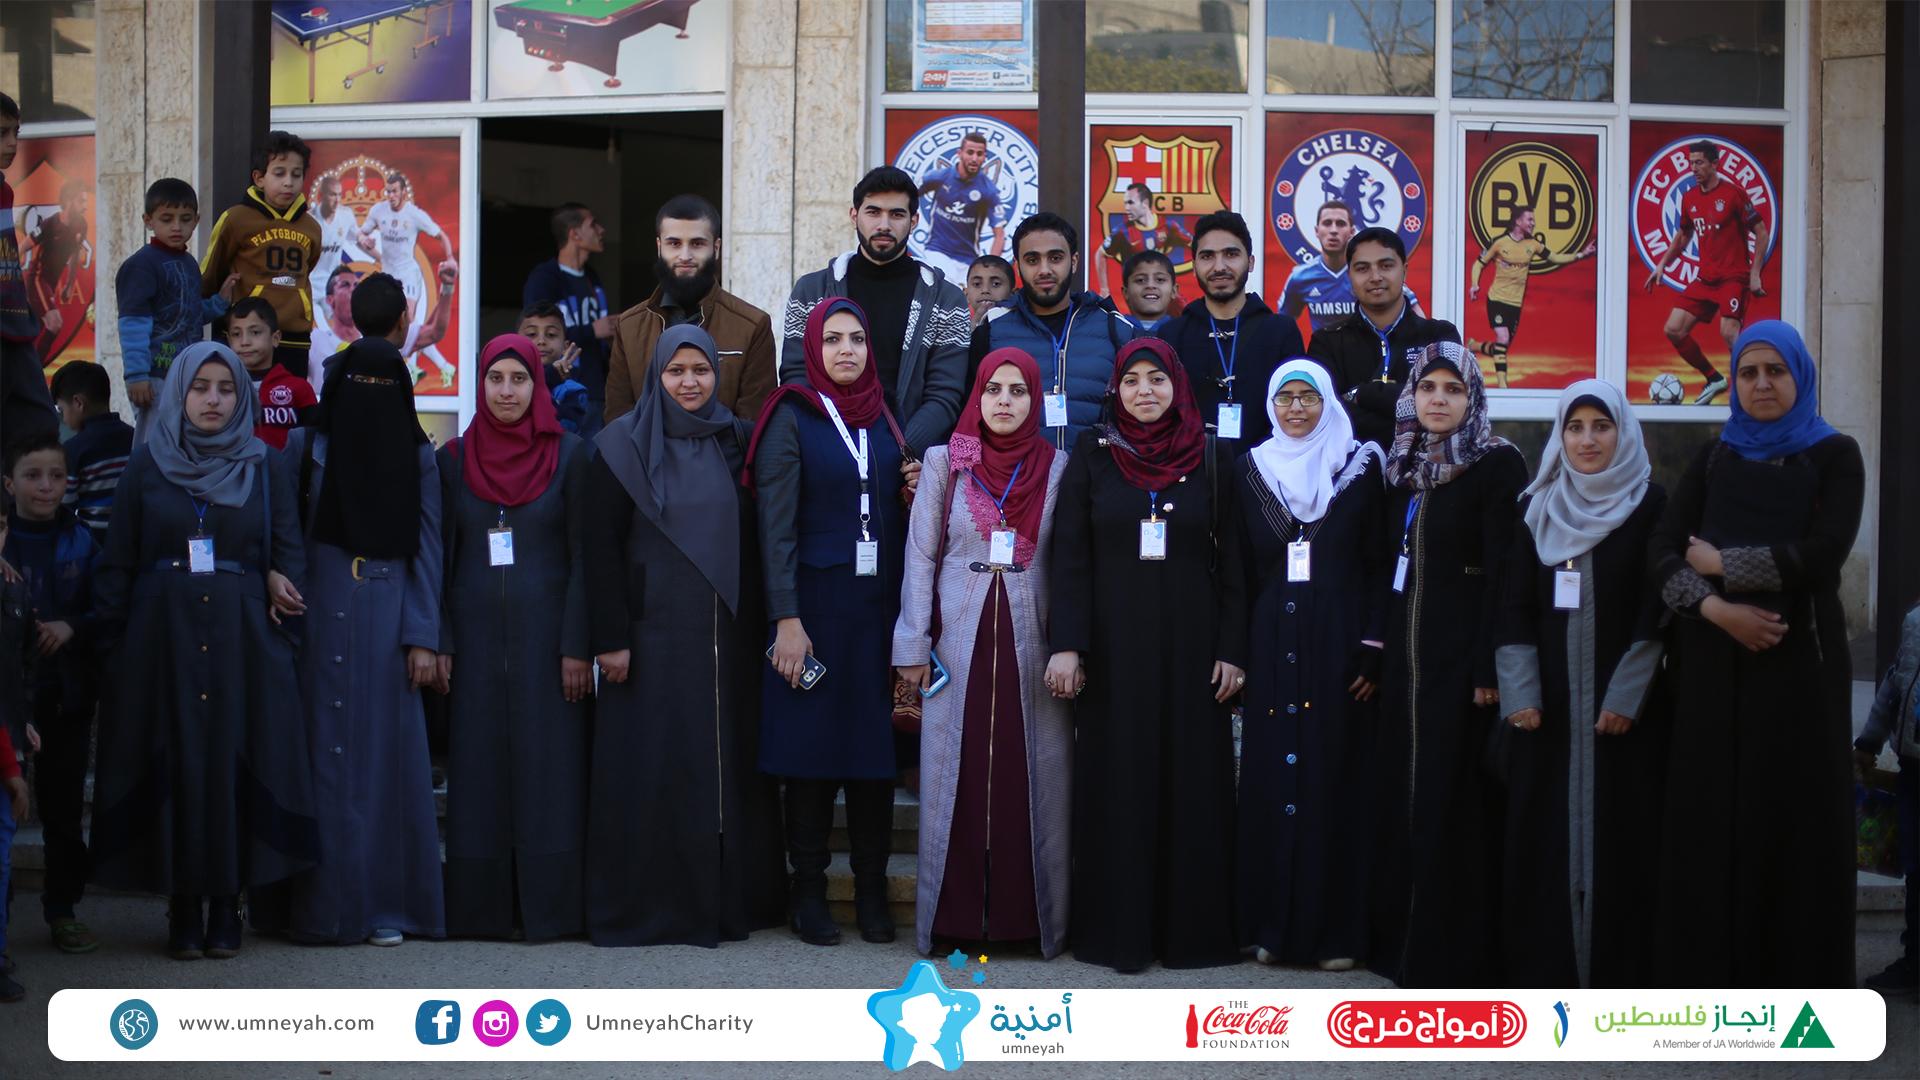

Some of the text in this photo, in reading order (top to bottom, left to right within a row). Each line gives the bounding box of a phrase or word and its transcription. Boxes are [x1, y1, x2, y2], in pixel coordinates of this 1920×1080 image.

[903, 126, 1039, 189] EICESTER CITY
[1297, 134, 1398, 168] CHELSEA
[1492, 162, 1577, 230] BVB
[1643, 169, 1670, 205] FC
[1154, 196, 1184, 212] CB
[251, 228, 311, 248] PLAYGROUN
[266, 246, 303, 272] 09
[1308, 302, 1356, 315] SAMSU
[1729, 298, 1739, 313] 9
